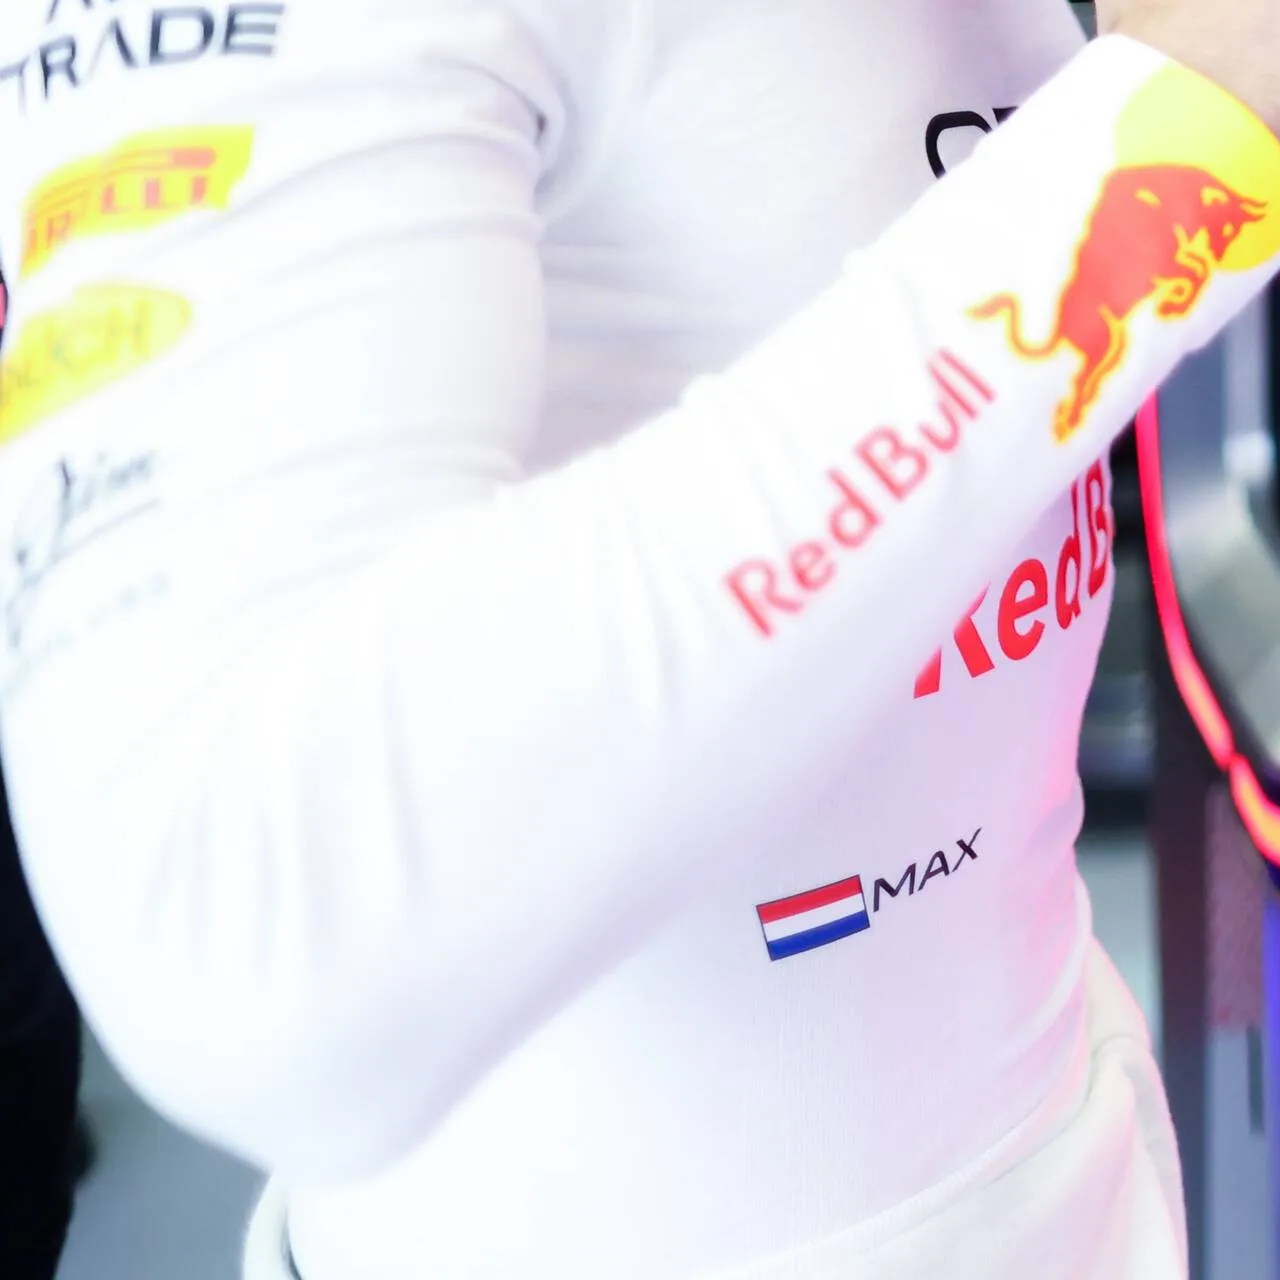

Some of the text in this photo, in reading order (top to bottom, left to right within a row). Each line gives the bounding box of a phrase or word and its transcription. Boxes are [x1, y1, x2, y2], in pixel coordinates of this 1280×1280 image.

[0, 2, 286, 117] TRADE
[722, 466, 884, 640] Red
[852, 346, 997, 504] Bull
[872, 826, 983, 913] MAX
